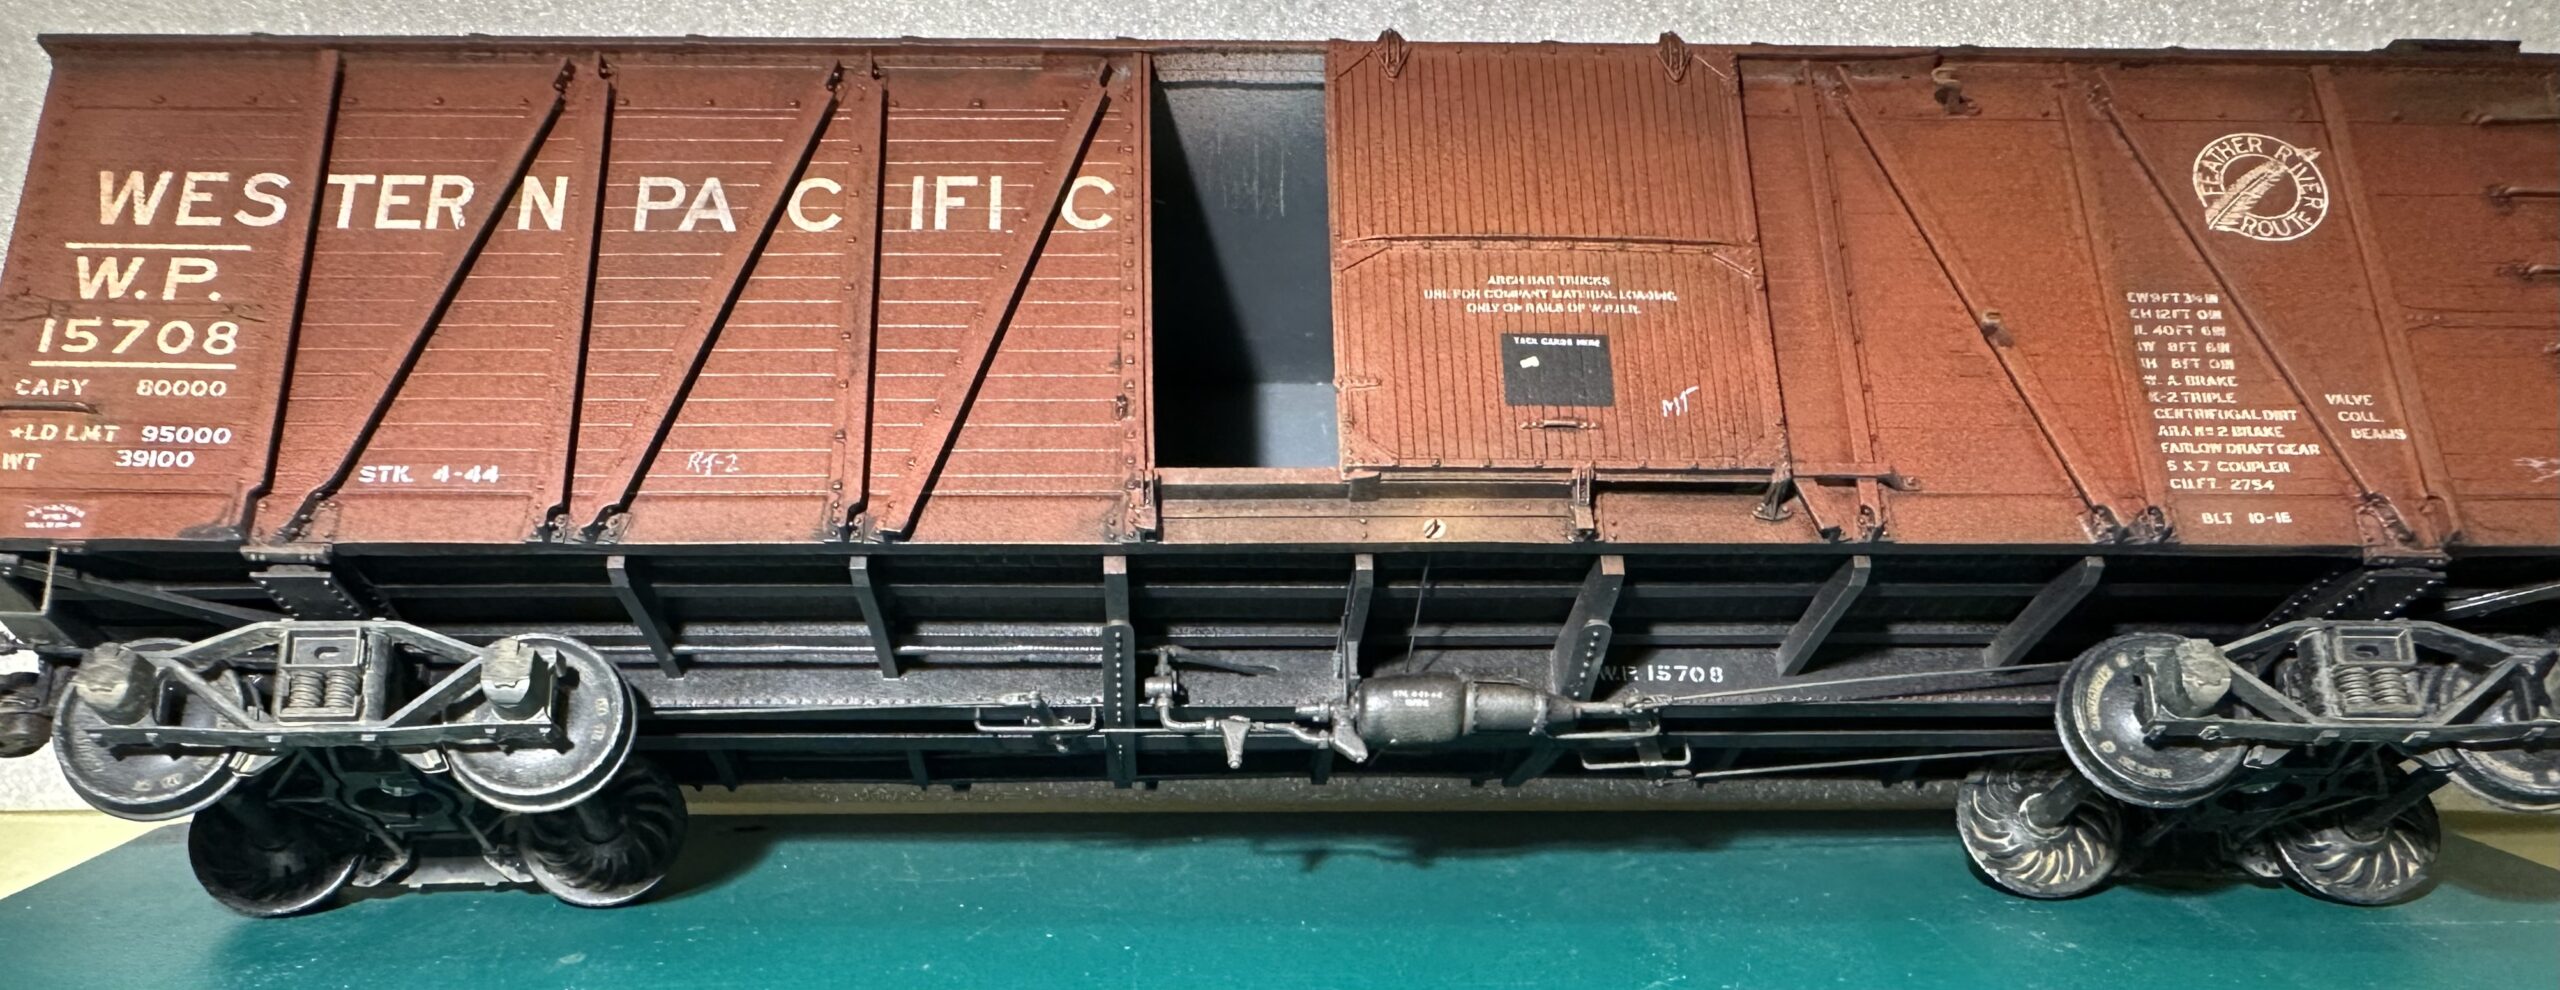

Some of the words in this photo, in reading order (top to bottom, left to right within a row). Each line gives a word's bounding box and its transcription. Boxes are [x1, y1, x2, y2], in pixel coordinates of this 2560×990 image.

[2198, 136, 2264, 197] FEATHER
[2273, 145, 2325, 209] RIVER
[2240, 210, 2313, 237] ROUTE
[77, 256, 221, 301] W.P.
[1488, 275, 1524, 286] ARCH
[1528, 275, 1555, 286] BAR
[1557, 275, 1610, 286] TRUCKS
[1484, 288, 1548, 300] COMPANY
[1467, 302, 1499, 314] ONLY
[1526, 302, 1563, 314] RAILS
[38, 317, 239, 355] 15708
[15, 379, 89, 395] CAPY
[137, 380, 227, 396] 80000
[2185, 375, 2238, 387] BRAKE
[2181, 391, 2236, 404] TRIPLE
[2325, 393, 2373, 406] VALVE
[2154, 407, 2261, 421] CENTRIFUGAL
[142, 426, 232, 444] 95000
[2158, 425, 2192, 437] ARA
[2232, 425, 2284, 438] BRAKE
[2351, 427, 2407, 441] BEAMS
[2161, 442, 2222, 455] FARLOW
[2226, 442, 2274, 455] DRAFT
[2277, 443, 2320, 456] GEAR
[115, 450, 195, 467] 39100
[359, 466, 414, 483] STK
[433, 465, 499, 483] 4-44
[2198, 460, 2210, 472] 7
[2217, 460, 2290, 474] COUPLER
[2231, 478, 2274, 491] 2754
[2202, 511, 2232, 525] BLT
[1648, 665, 1723, 682] 15708
